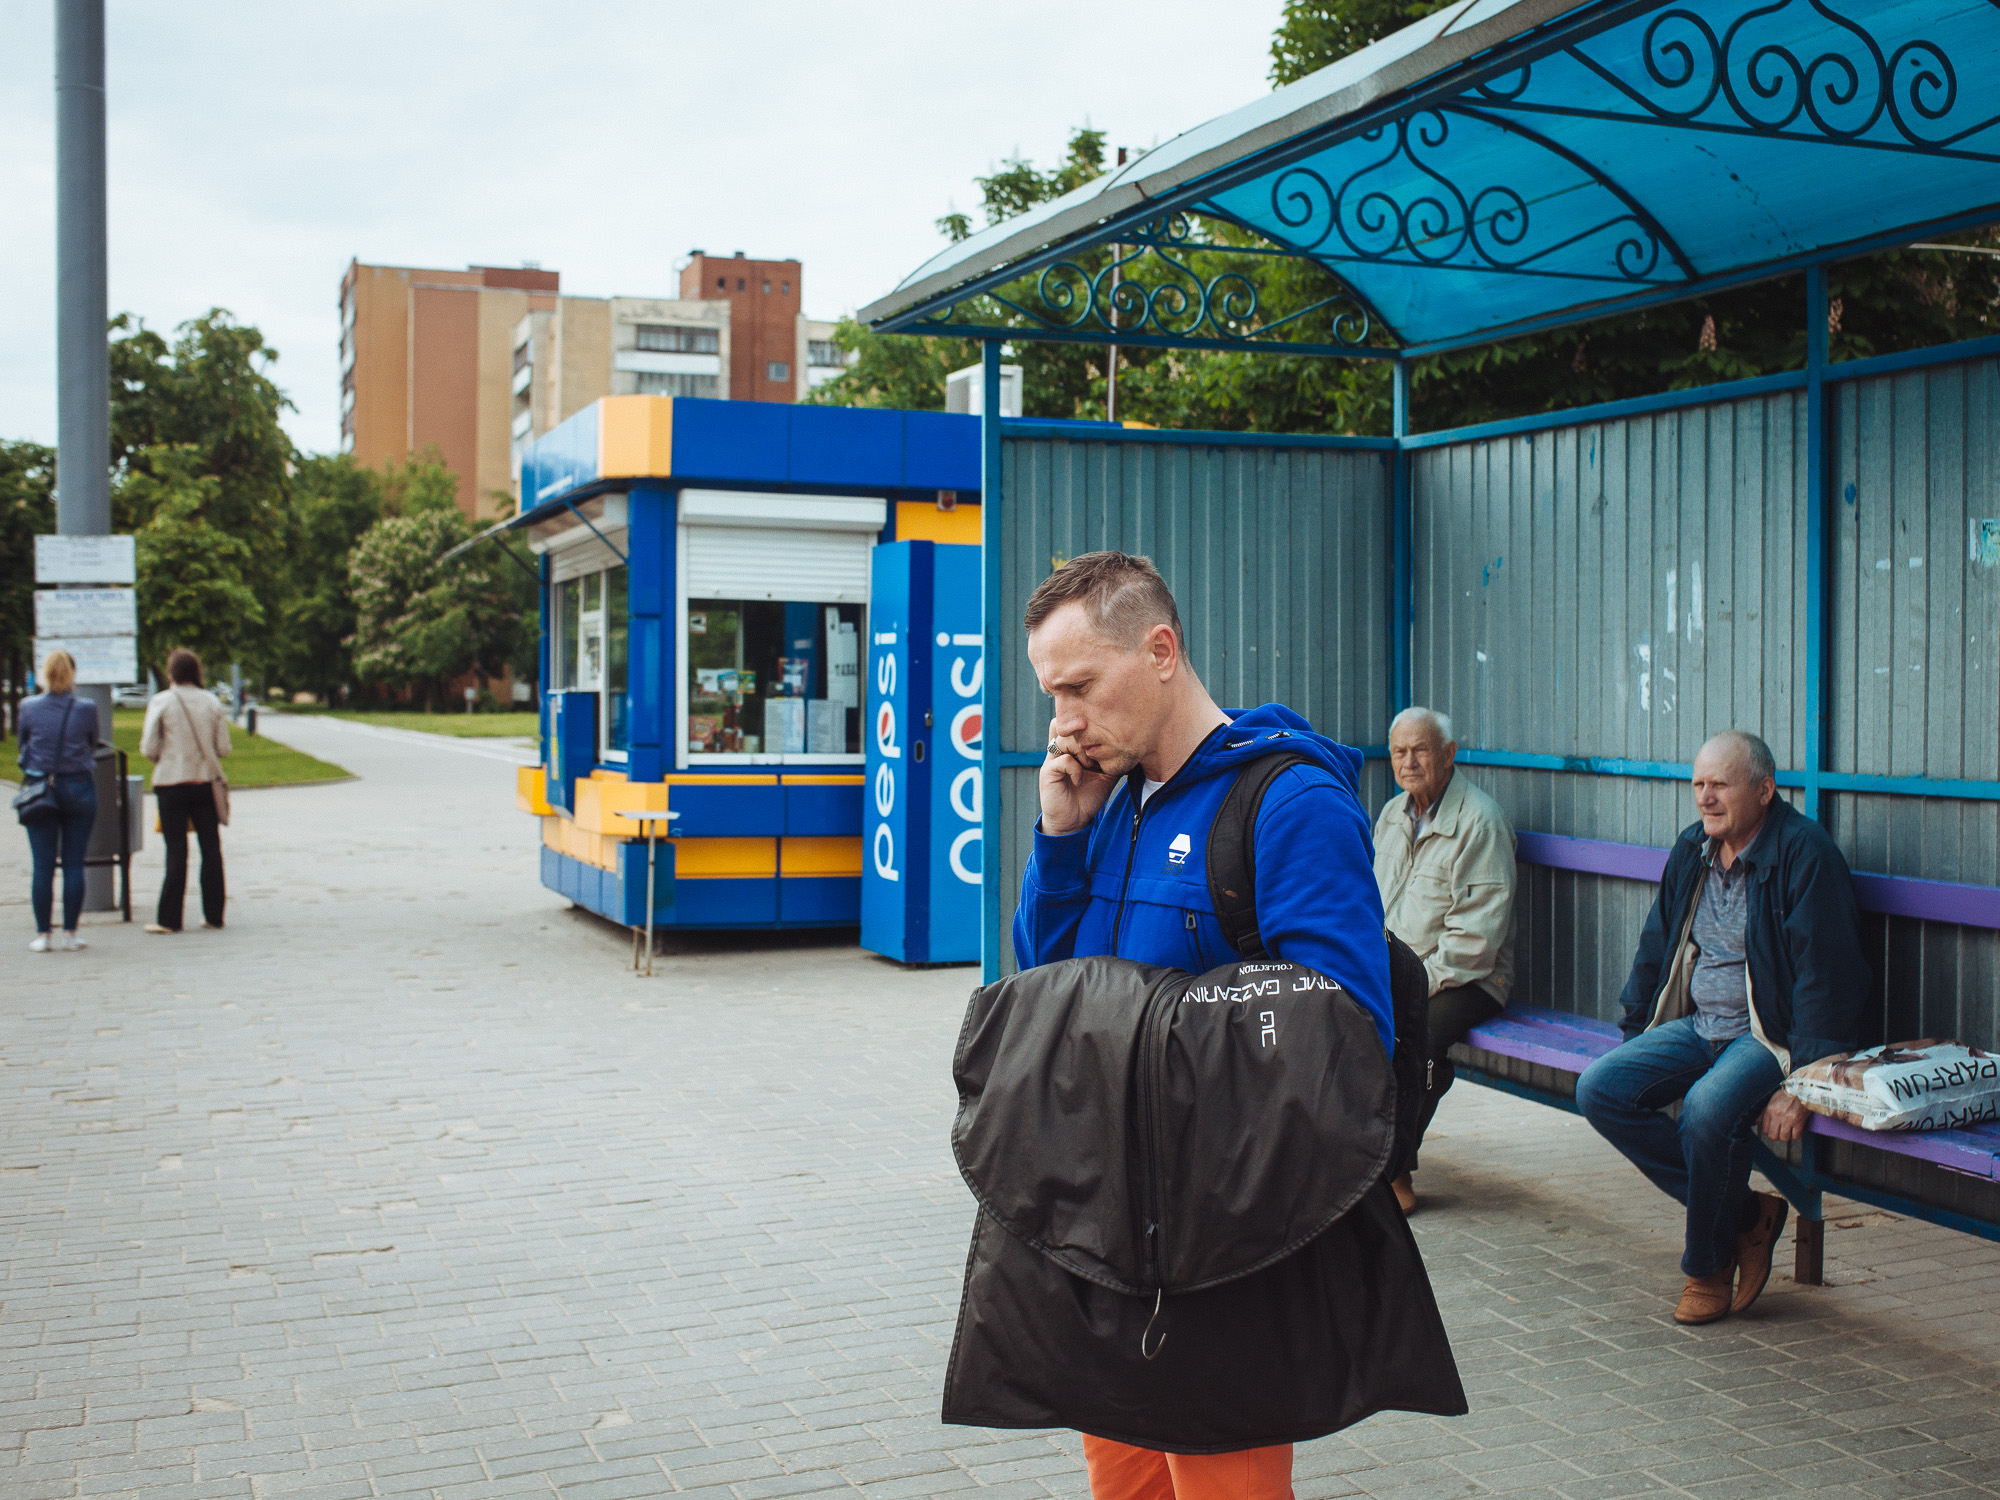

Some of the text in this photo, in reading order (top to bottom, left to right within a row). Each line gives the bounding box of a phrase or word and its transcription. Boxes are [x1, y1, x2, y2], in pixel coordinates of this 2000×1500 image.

[874, 631, 900, 882] pepsi
[1239, 964, 1293, 976] COLLECTION
[1886, 1060, 1998, 1102] PARFUM
